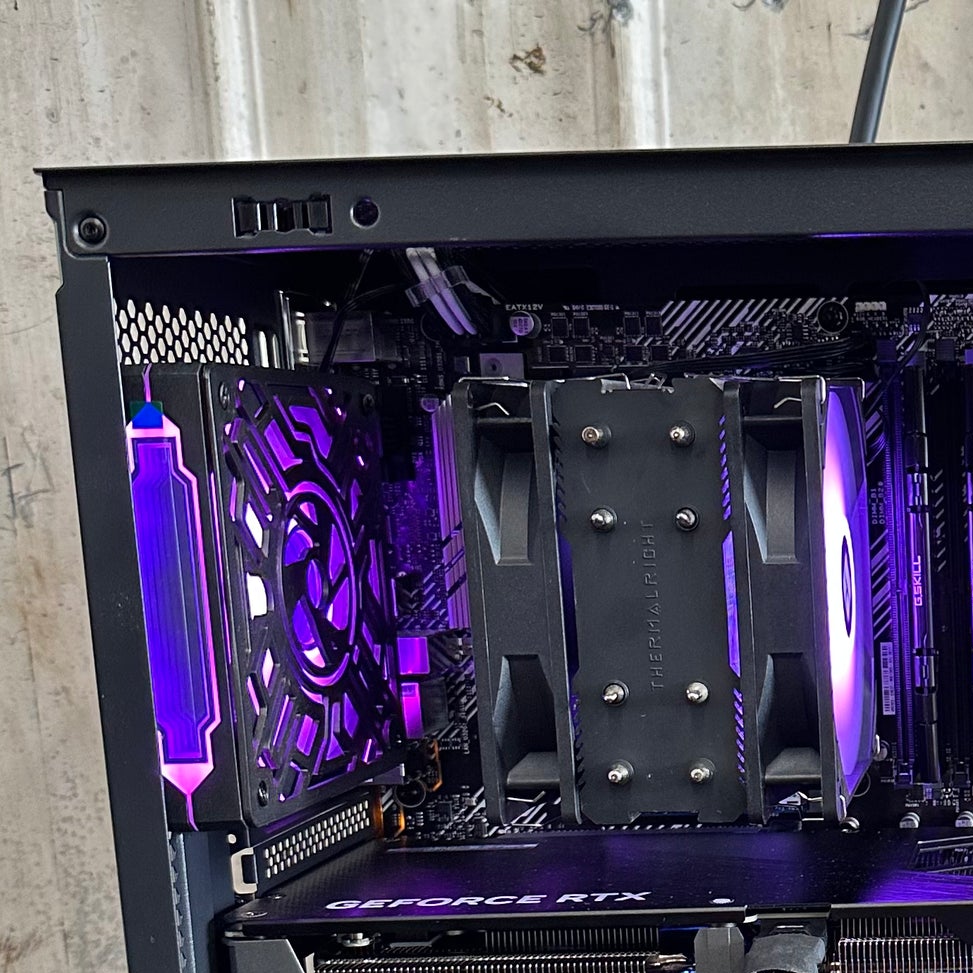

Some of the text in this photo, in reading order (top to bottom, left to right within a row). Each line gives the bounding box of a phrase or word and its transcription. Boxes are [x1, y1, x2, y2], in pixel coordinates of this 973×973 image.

[640, 520, 664, 691] THERMALRIGHT
[912, 555, 923, 607] G.SKILL
[325, 892, 652, 910] GEFORCE RTX
